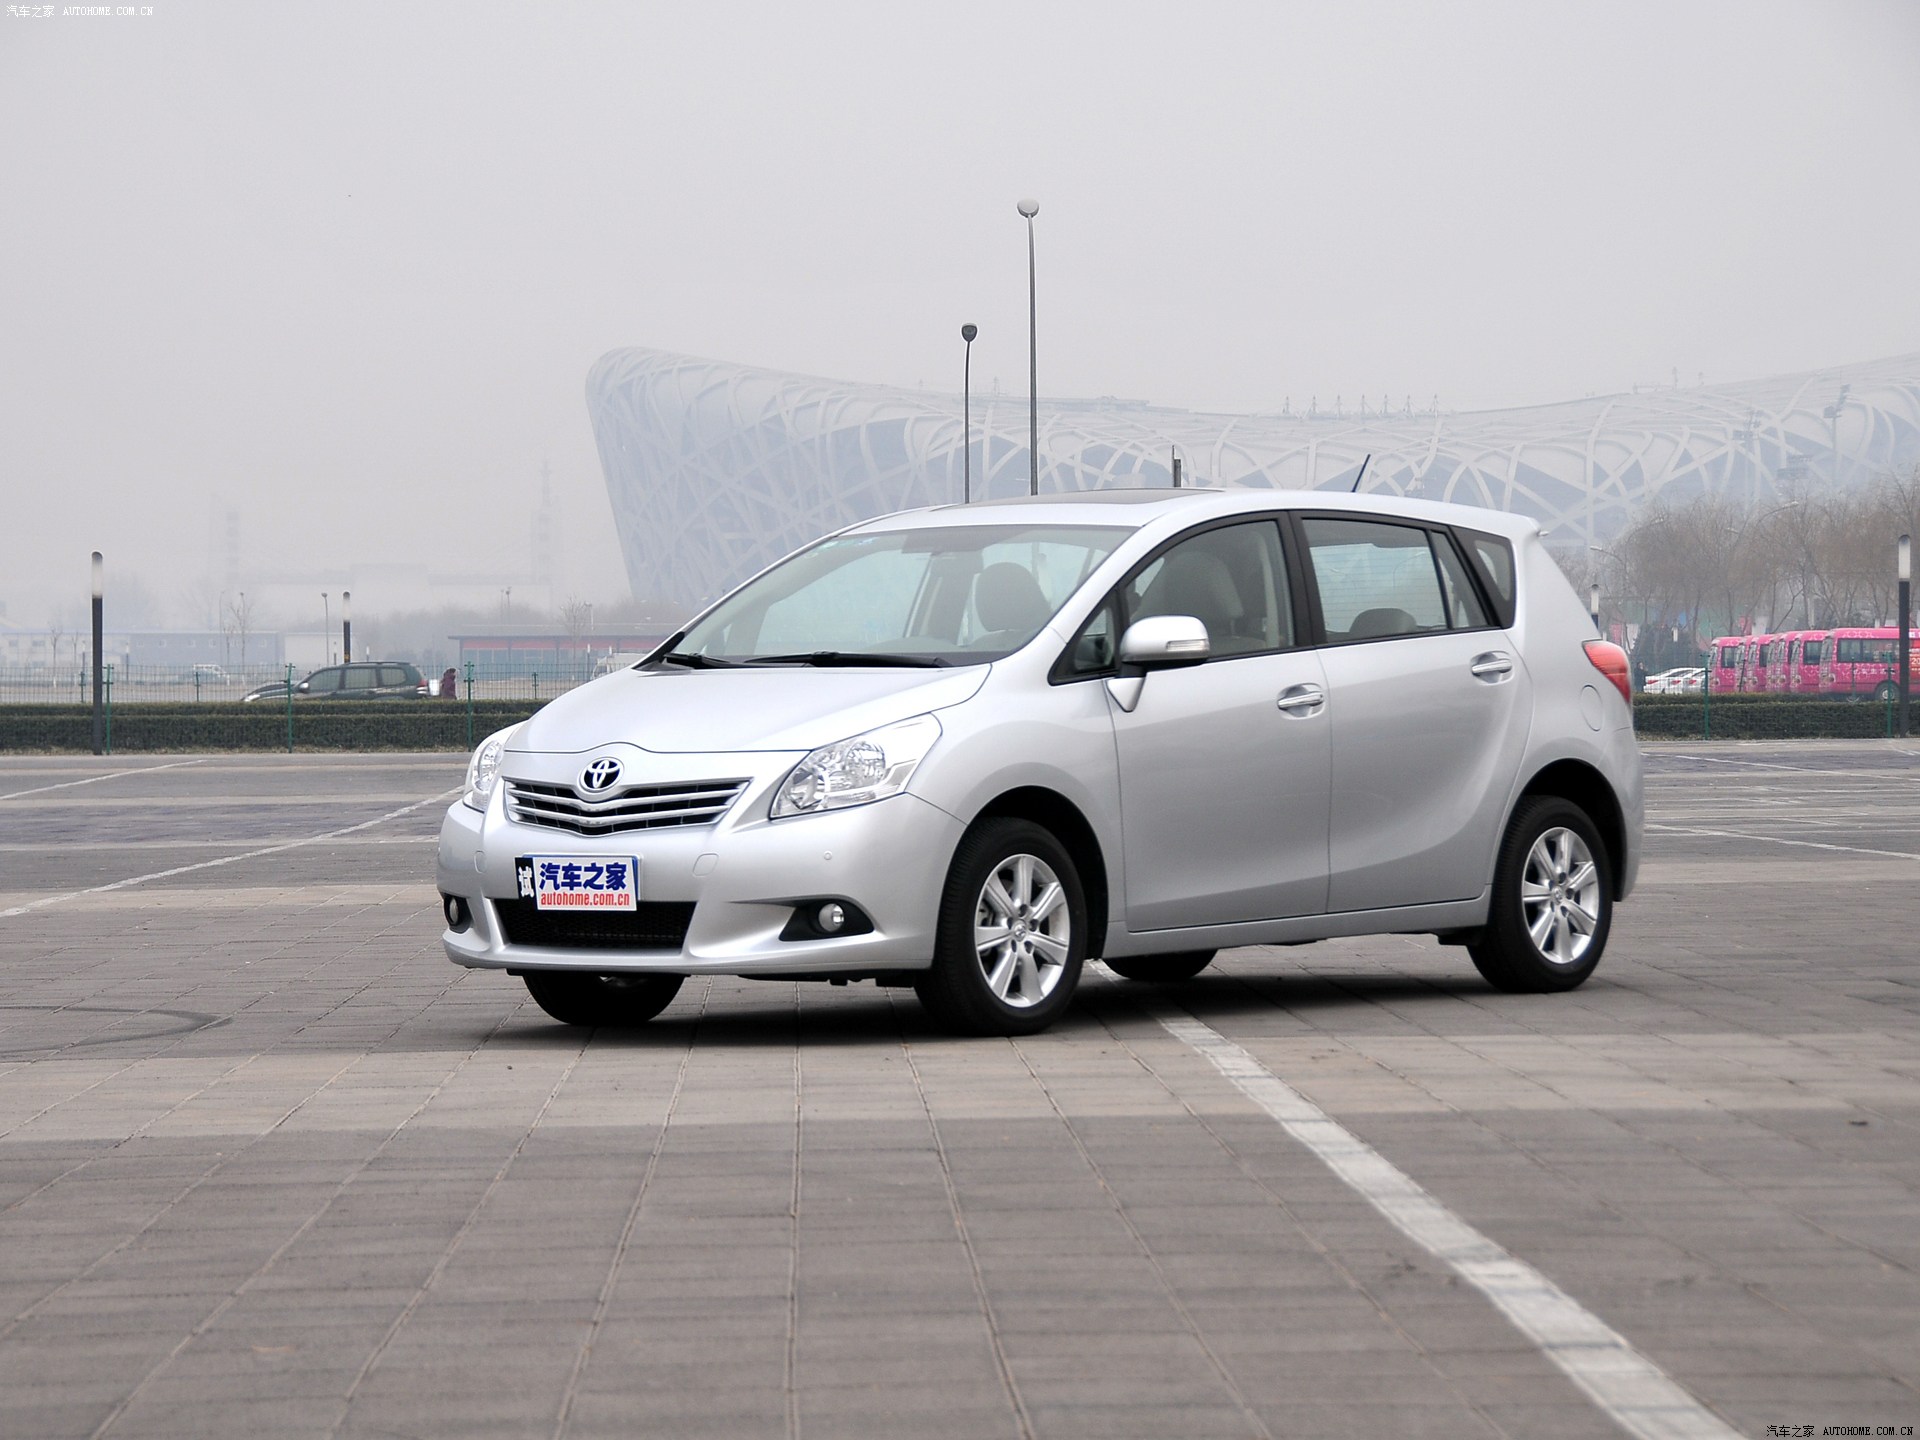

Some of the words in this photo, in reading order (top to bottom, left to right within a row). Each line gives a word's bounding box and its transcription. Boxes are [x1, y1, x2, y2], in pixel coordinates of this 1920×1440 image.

[518, 866, 534, 898] 试
[539, 862, 627, 891] 汽车之家
[540, 892, 630, 906] autohome.com.cn
